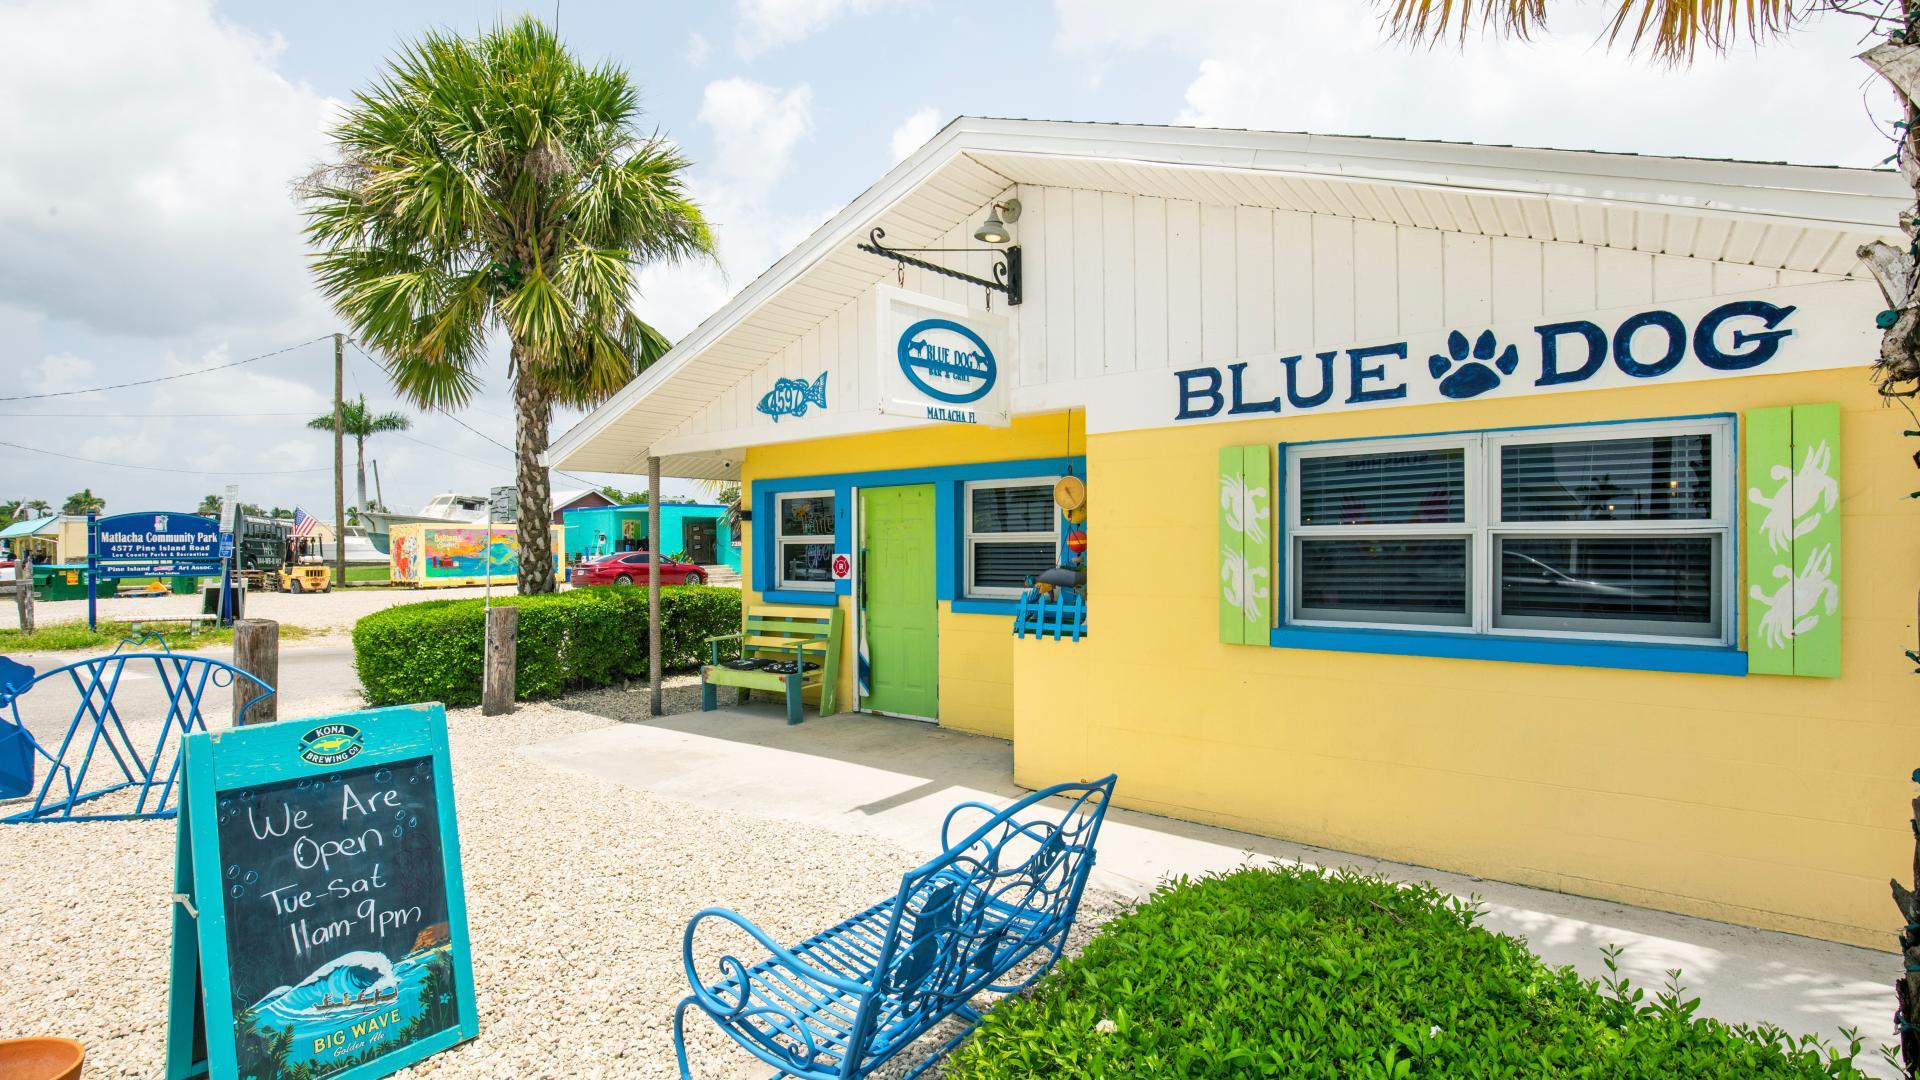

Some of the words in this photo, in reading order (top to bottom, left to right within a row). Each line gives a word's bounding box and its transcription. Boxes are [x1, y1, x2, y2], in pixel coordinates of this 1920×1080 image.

[926, 344, 949, 366] BLUE
[954, 350, 973, 369] DOG
[1174, 341, 1408, 421] BLUE
[1534, 300, 1796, 387] DOG
[953, 371, 970, 382] GRILL
[768, 386, 799, 412] 4597
[927, 406, 966, 423] MATLACHA
[968, 413, 977, 424] FL
[101, 532, 144, 543] Matlacha
[146, 532, 196, 544] Community
[197, 532, 218, 543] Park
[315, 725, 345, 737] KONA
[306, 752, 348, 764] BREWING
[248, 803, 314, 840] We
[342, 784, 401, 821] Are
[293, 828, 383, 871] Open
[290, 898, 422, 955] 11am-9pm
[314, 1030, 346, 1054] BIG
[350, 1008, 400, 1039] WAVE
[333, 1041, 365, 1057] Golden
[369, 1031, 385, 1044] Ale
